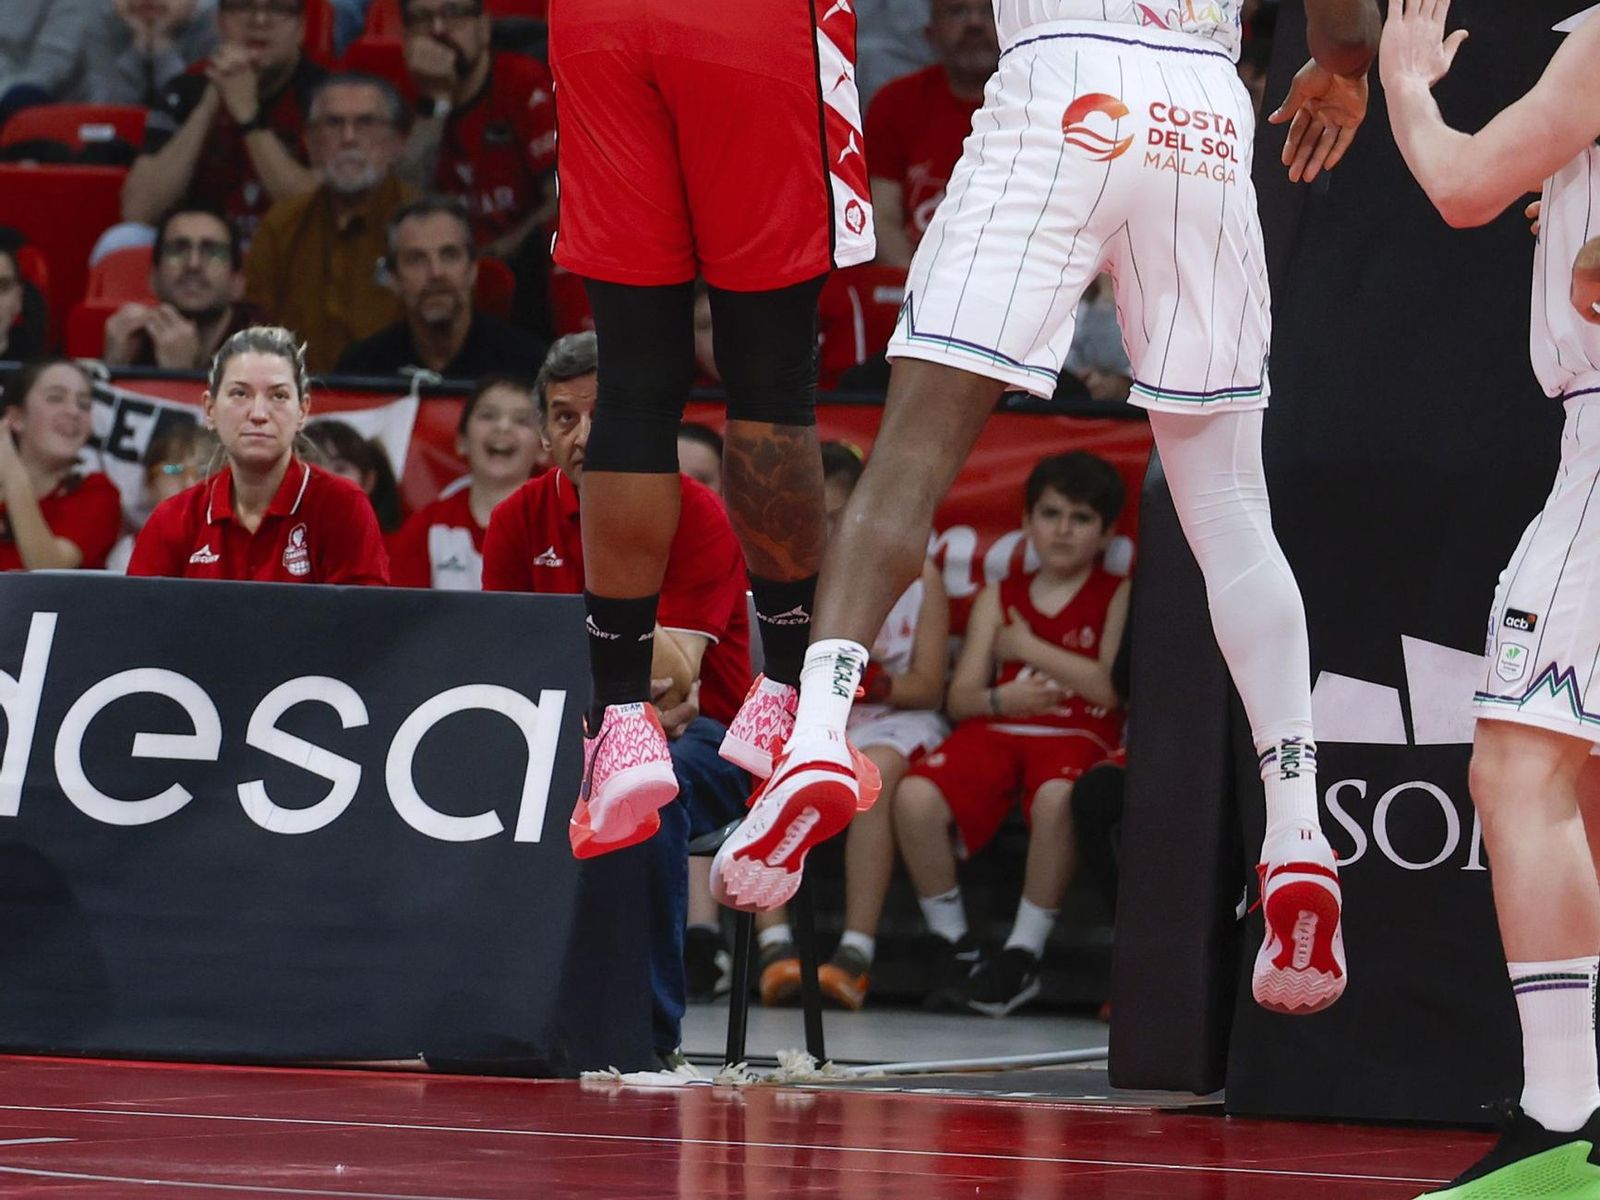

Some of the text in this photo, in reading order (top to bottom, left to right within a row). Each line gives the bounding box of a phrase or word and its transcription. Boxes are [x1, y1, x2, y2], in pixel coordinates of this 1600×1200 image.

[1149, 102, 1238, 141] COSTA
[1148, 128, 1239, 164] DEL SOL
[1143, 150, 1237, 187] MÁLAGA
[1505, 615, 1529, 630] acb
[1325, 779, 1488, 870] SO
